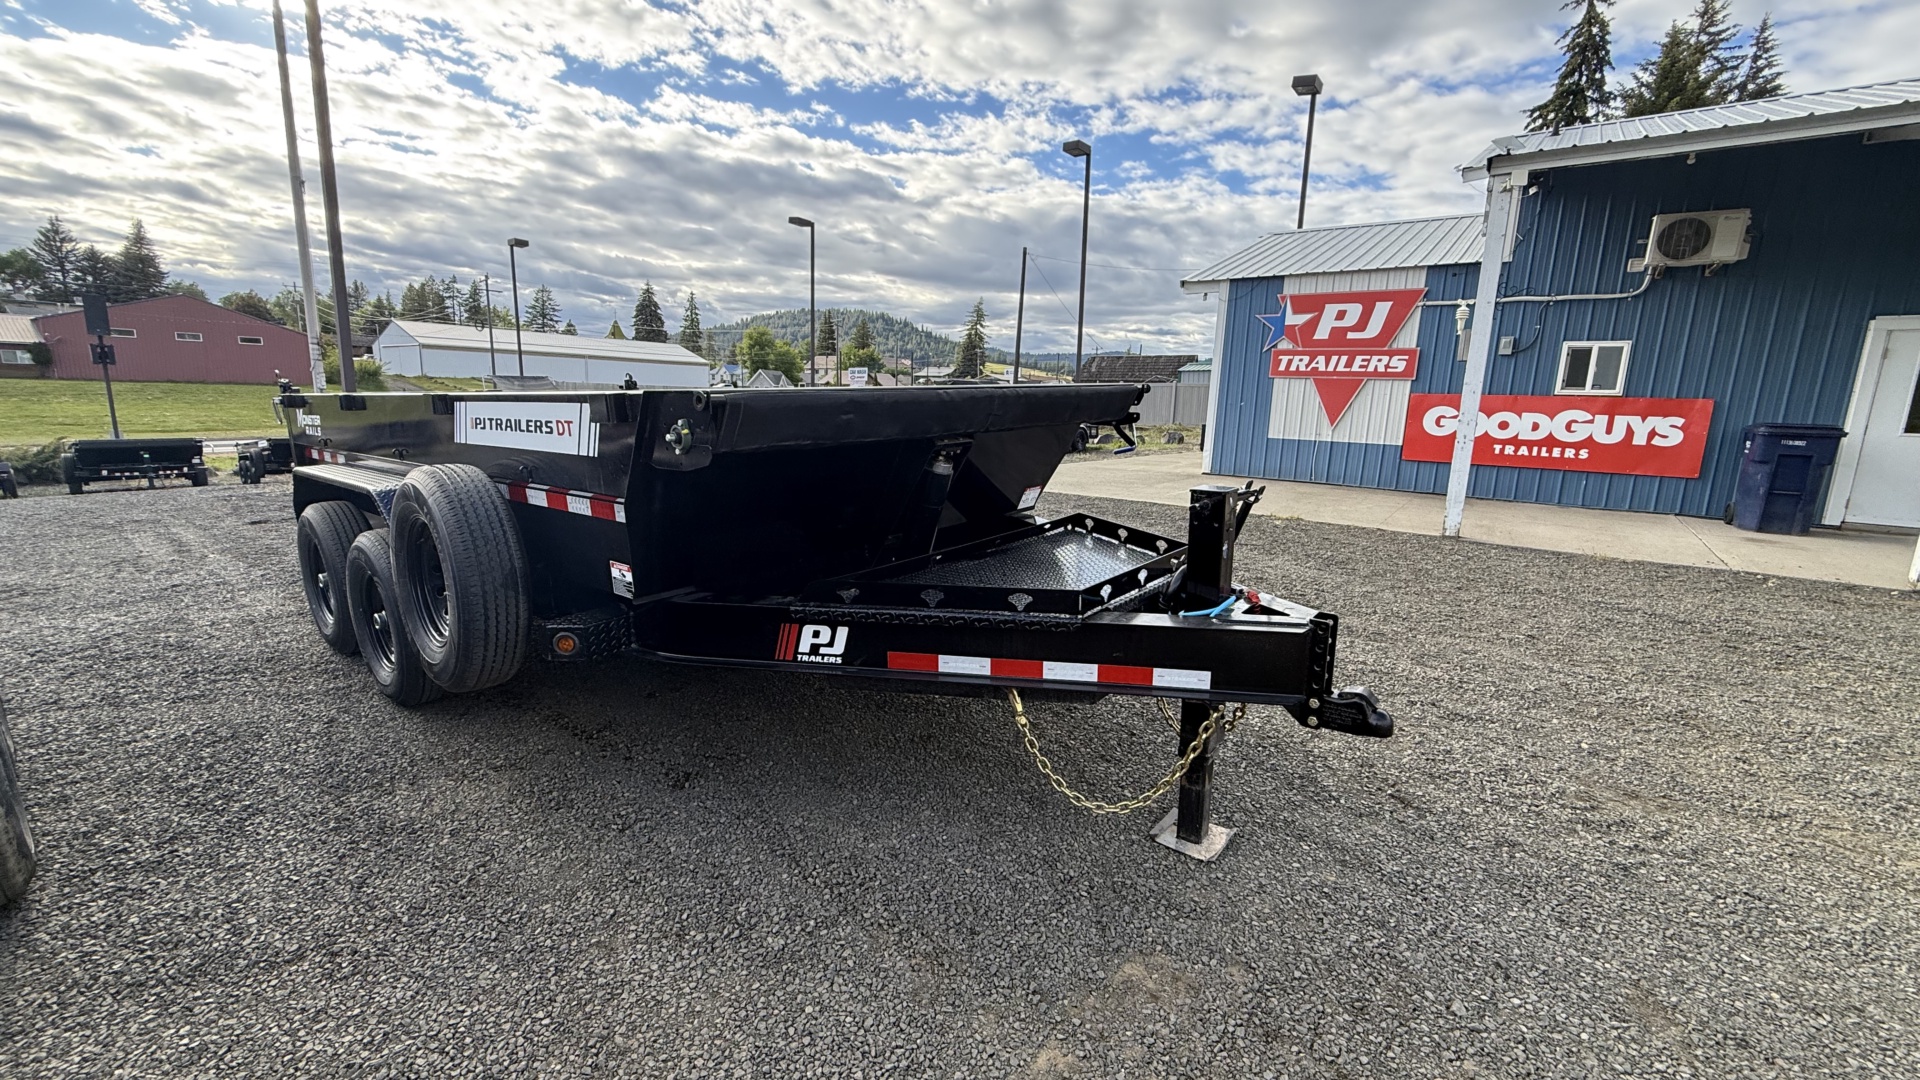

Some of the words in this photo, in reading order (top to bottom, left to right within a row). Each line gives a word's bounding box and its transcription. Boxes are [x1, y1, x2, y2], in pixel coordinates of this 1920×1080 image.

[1312, 301, 1393, 339] PJ
[1277, 355, 1410, 372] TRAILERS
[296, 408, 321, 427] MONSTER
[555, 420, 573, 437] DT
[1493, 444, 1589, 459] TRAILERS
[798, 624, 849, 655] PJ
[796, 654, 843, 664] TRAILERS
